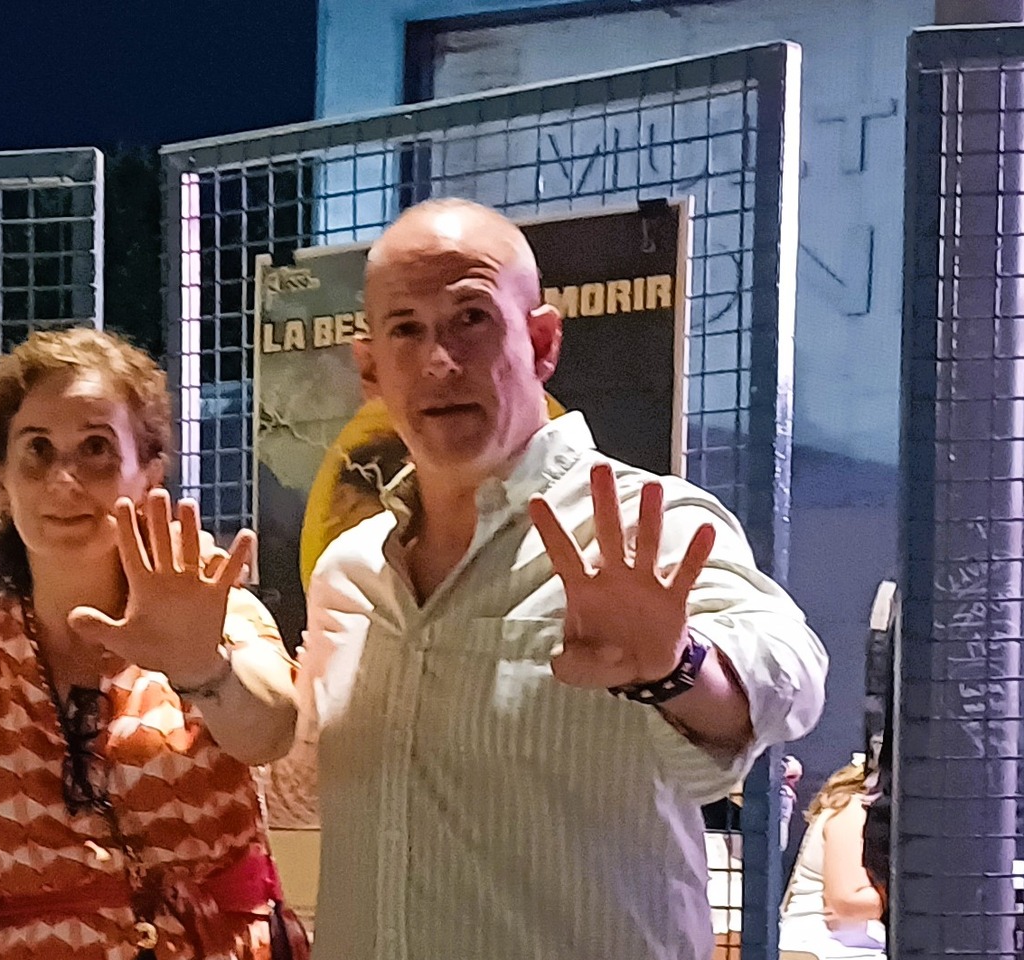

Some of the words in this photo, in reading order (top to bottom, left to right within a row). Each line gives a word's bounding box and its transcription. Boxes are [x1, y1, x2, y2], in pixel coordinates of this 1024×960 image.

[262, 320, 306, 353] LA
[313, 311, 371, 349] BES
[543, 274, 672, 318] MORIR
